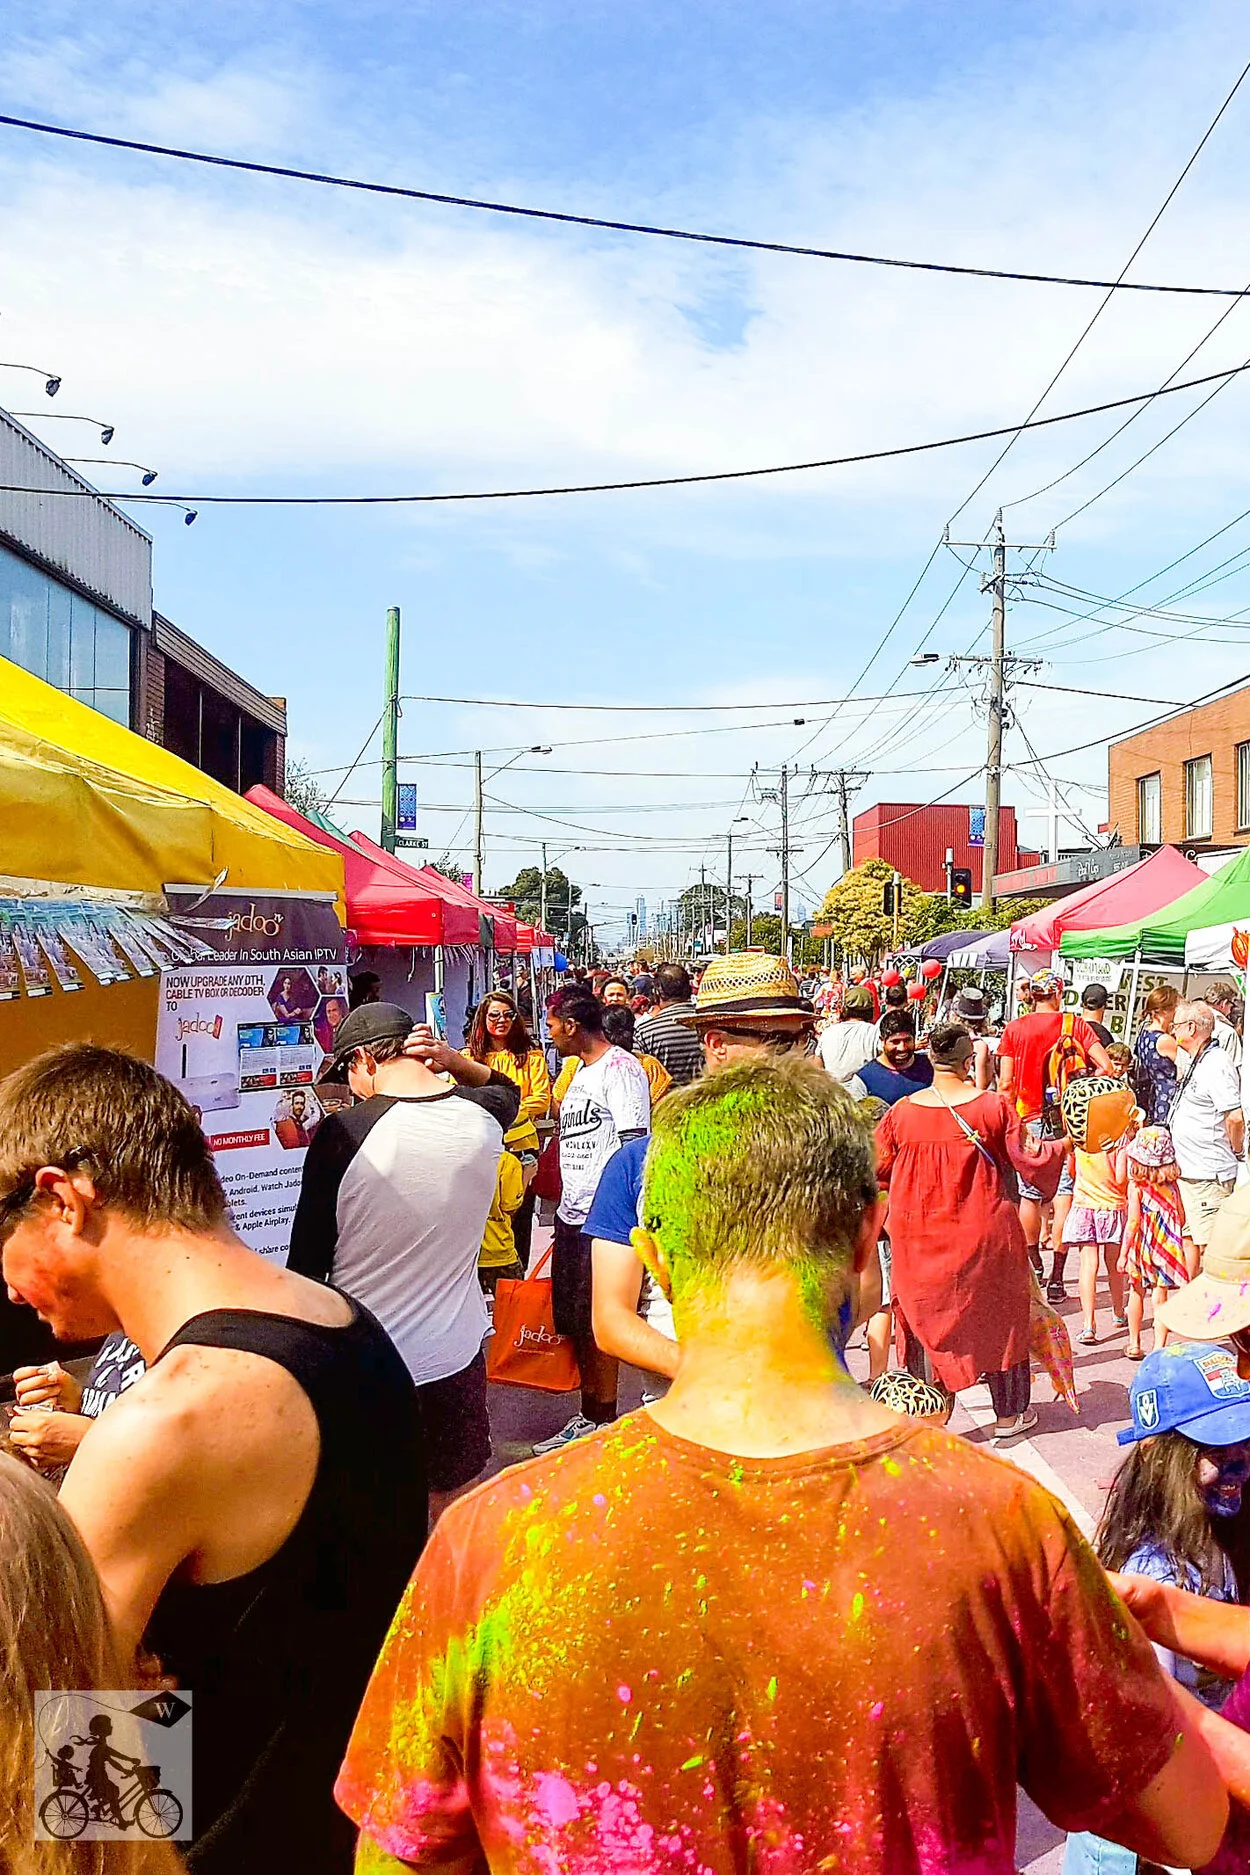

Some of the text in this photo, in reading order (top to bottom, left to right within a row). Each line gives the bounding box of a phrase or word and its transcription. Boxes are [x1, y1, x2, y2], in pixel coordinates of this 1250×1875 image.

[398, 839, 420, 847] CLARKE
[224, 903, 281, 941] jadoo
[239, 949, 250, 961] In
[250, 949, 282, 961] South
[283, 949, 313, 961] Asian
[314, 949, 337, 961] IPTV
[166, 977, 191, 988] NOW
[191, 976, 229, 988] UPGRADE
[229, 976, 244, 986] ANY
[165, 986, 264, 1000] CABLE TV BOX OR DECODER
[166, 1001, 178, 1011] TO
[222, 1134, 253, 1145] MONTHLY
[253, 1133, 266, 1142] FEE
[221, 1175, 234, 1183] deo
[234, 1167, 278, 1181] On-Demand
[260, 1184, 284, 1193] Watch
[284, 1180, 301, 1190] Jado
[248, 1208, 276, 1219] devices
[277, 1203, 297, 1214] simul
[242, 1220, 263, 1232] Apple
[513, 1323, 561, 1348] jadoo
